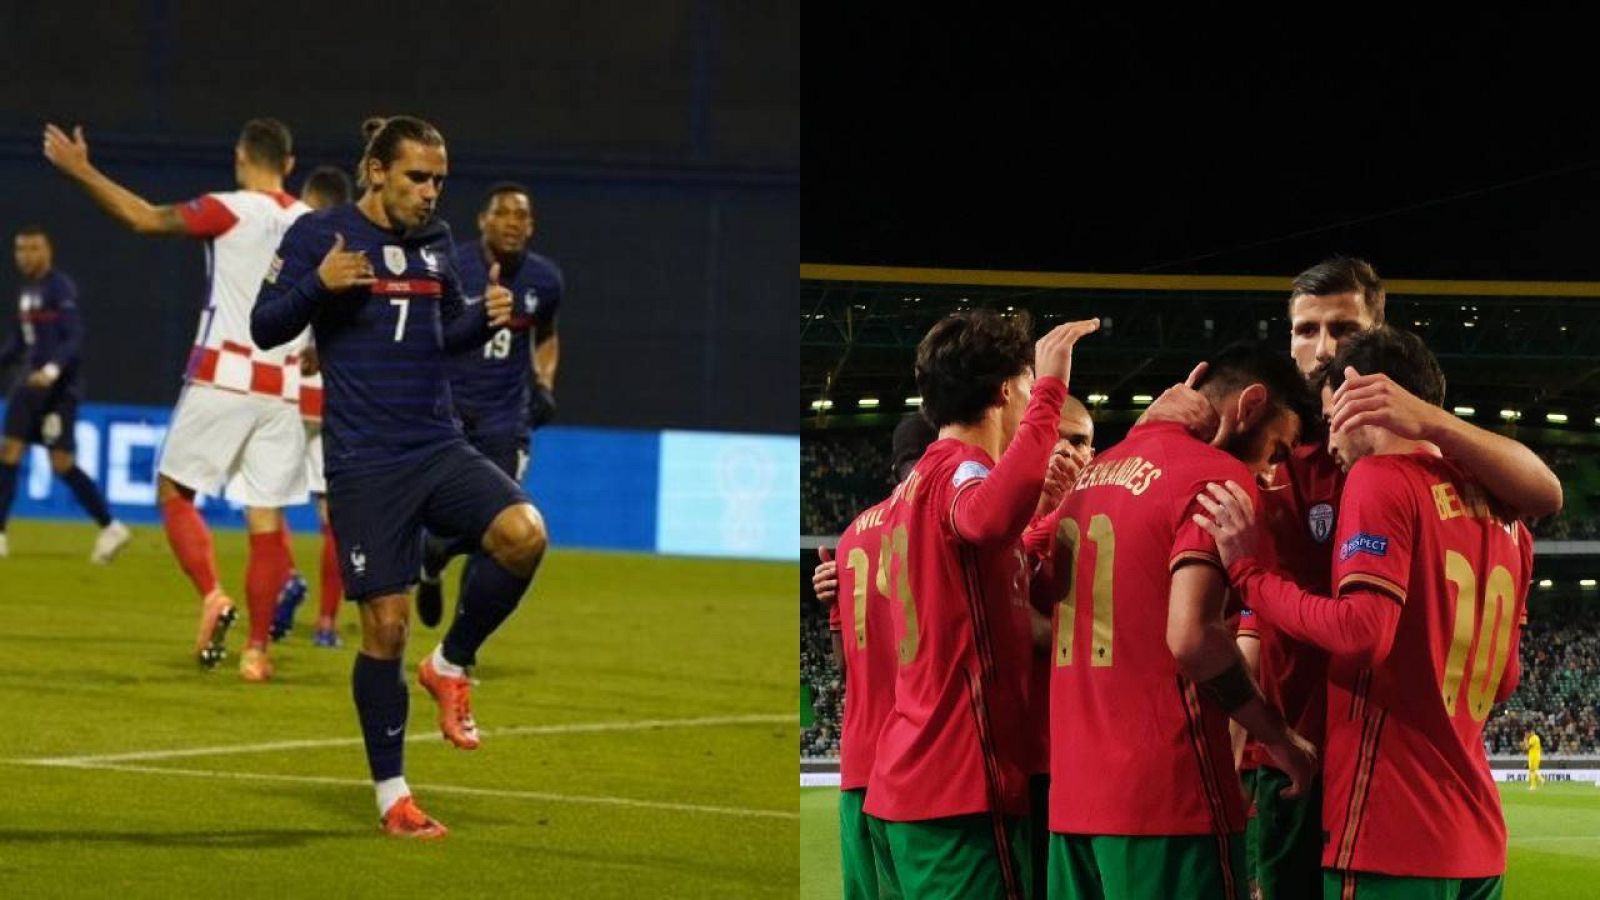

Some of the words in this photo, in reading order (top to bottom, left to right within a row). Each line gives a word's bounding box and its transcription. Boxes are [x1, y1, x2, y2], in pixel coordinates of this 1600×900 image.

[389, 298, 409, 342] 7
[483, 327, 511, 359] 19
[1056, 513, 1115, 667] 11
[1442, 549, 1515, 721] 10
